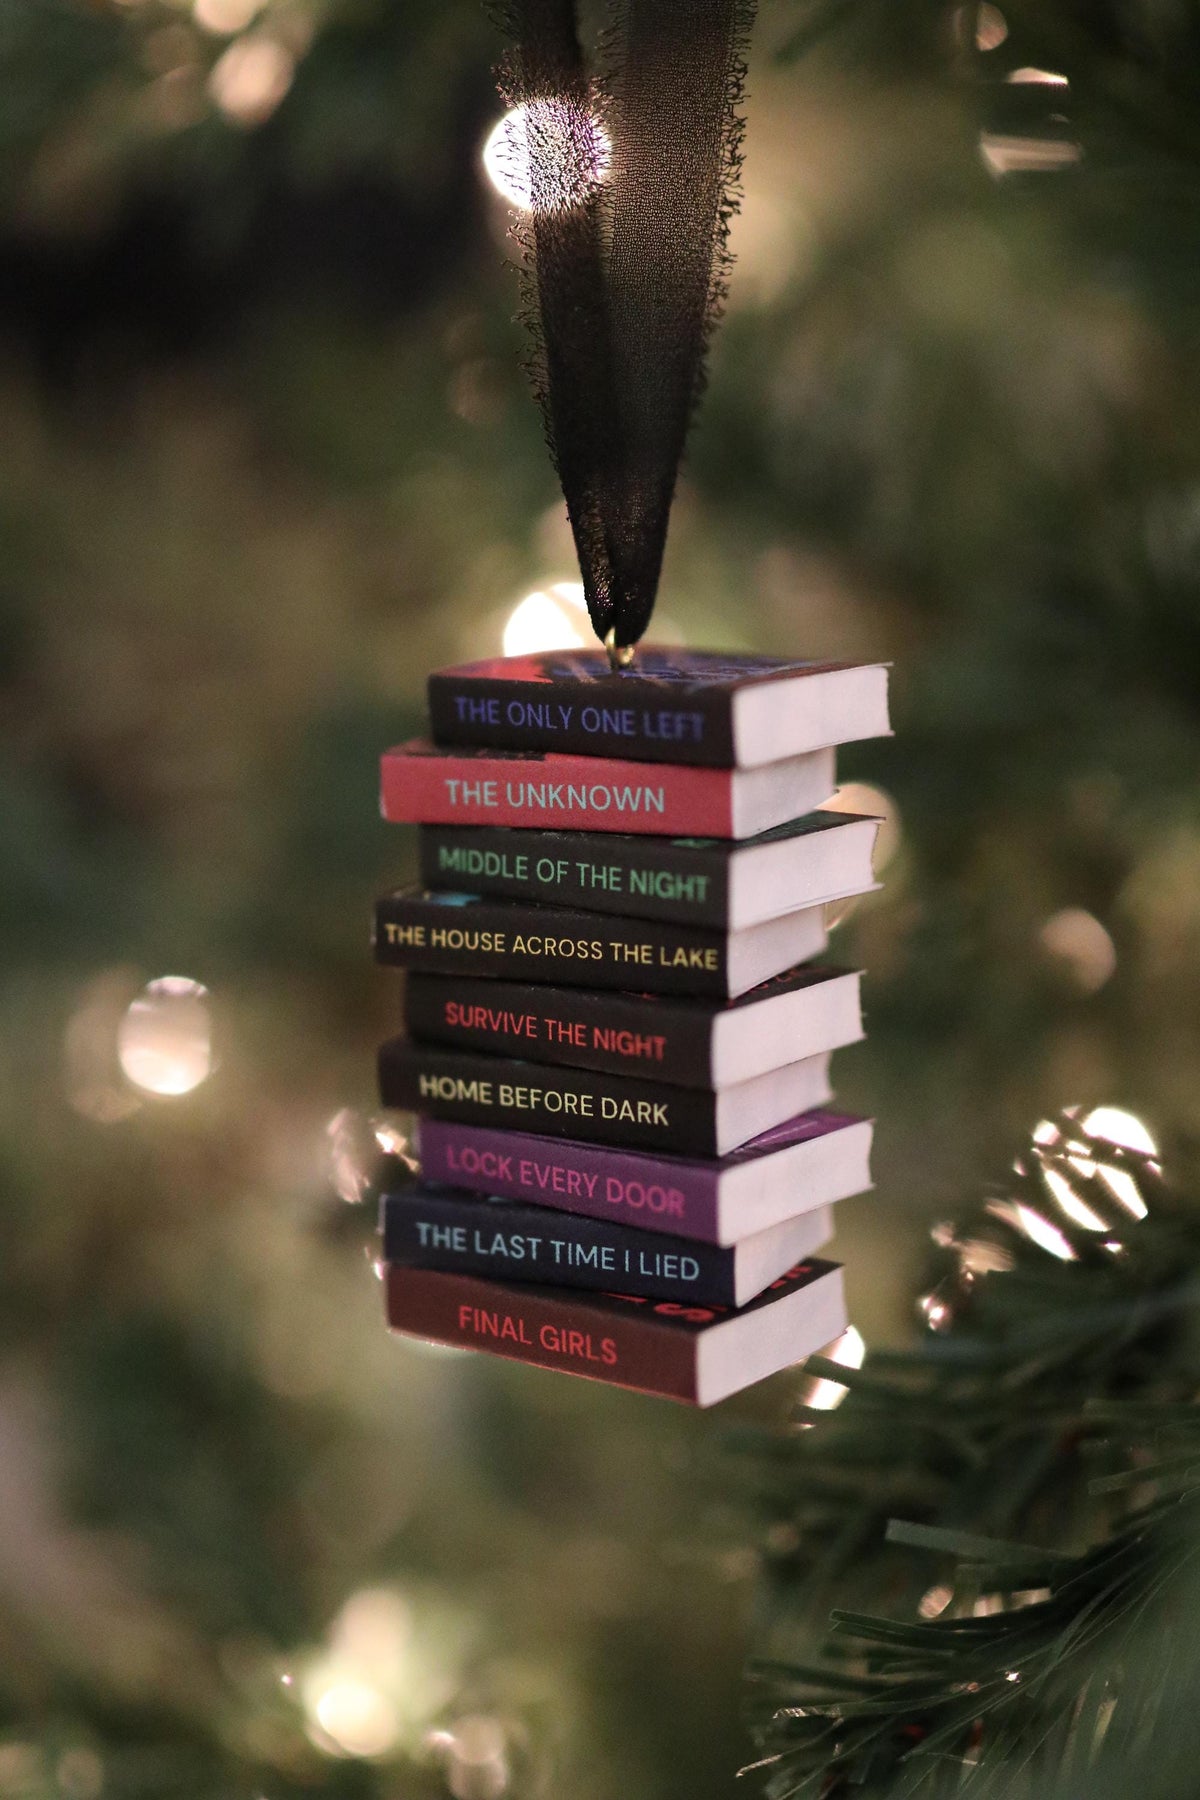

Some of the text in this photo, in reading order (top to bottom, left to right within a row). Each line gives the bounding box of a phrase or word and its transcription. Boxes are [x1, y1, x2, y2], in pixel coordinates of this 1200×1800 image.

[454, 697, 704, 741] THE ONLY ONE LEFT
[445, 779, 664, 813] THE UNKNOWN
[439, 846, 709, 900] MIDDLE OF THE NIGHT
[385, 923, 719, 970] THE HOUSE ACROSS THE LAKE
[445, 1002, 665, 1061] SURVIVE THE NIGHT
[419, 1074, 669, 1126] HOME BEFORE DARK
[446, 1144, 685, 1218] LOCK EVERY DOOR
[416, 1222, 699, 1281] THE LAST TIME I LIED
[458, 1306, 617, 1365] FINAL GIRLS
